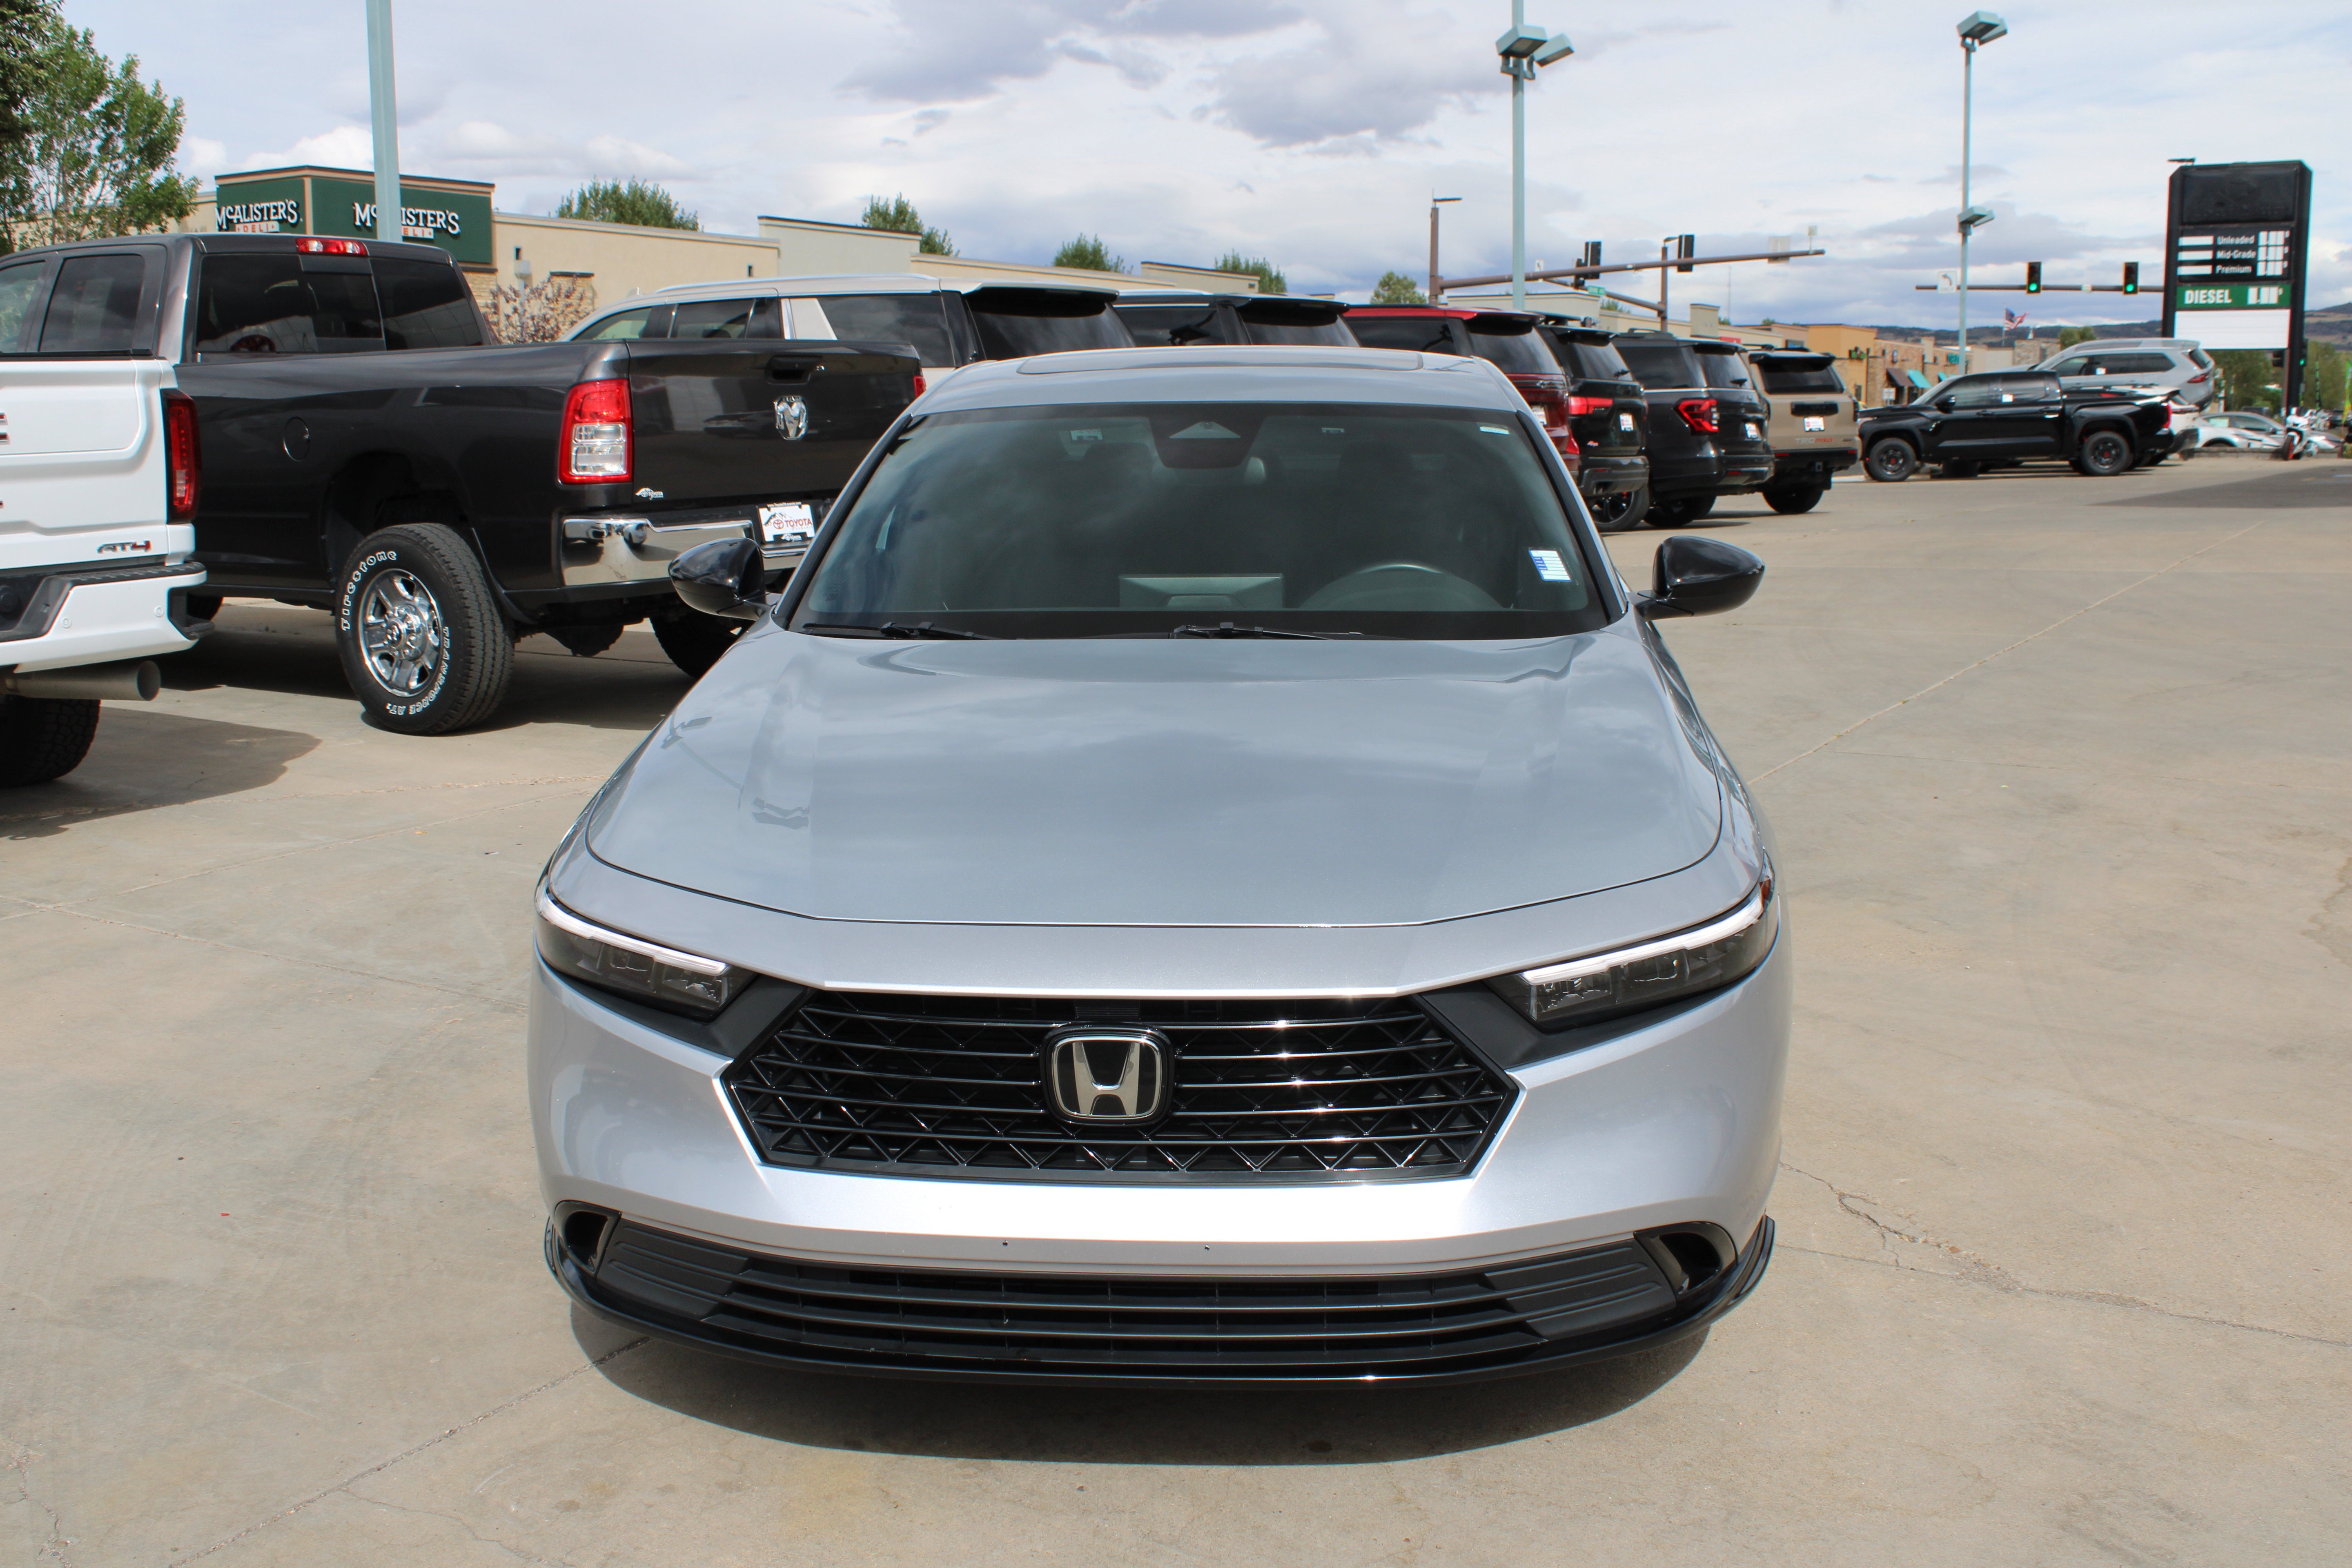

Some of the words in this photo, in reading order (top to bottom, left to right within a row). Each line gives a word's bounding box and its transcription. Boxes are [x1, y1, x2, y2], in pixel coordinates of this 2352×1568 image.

[243, 223, 269, 233] DELI
[403, 227, 425, 237] ELI
[2216, 235, 2255, 245] Unleaded
[2216, 250, 2257, 259] Mid-Grade
[2215, 265, 2252, 274] Premium
[2184, 289, 2233, 304] DIESEL
[784, 518, 813, 528] TOYOTA
[97, 540, 151, 554] AT4
